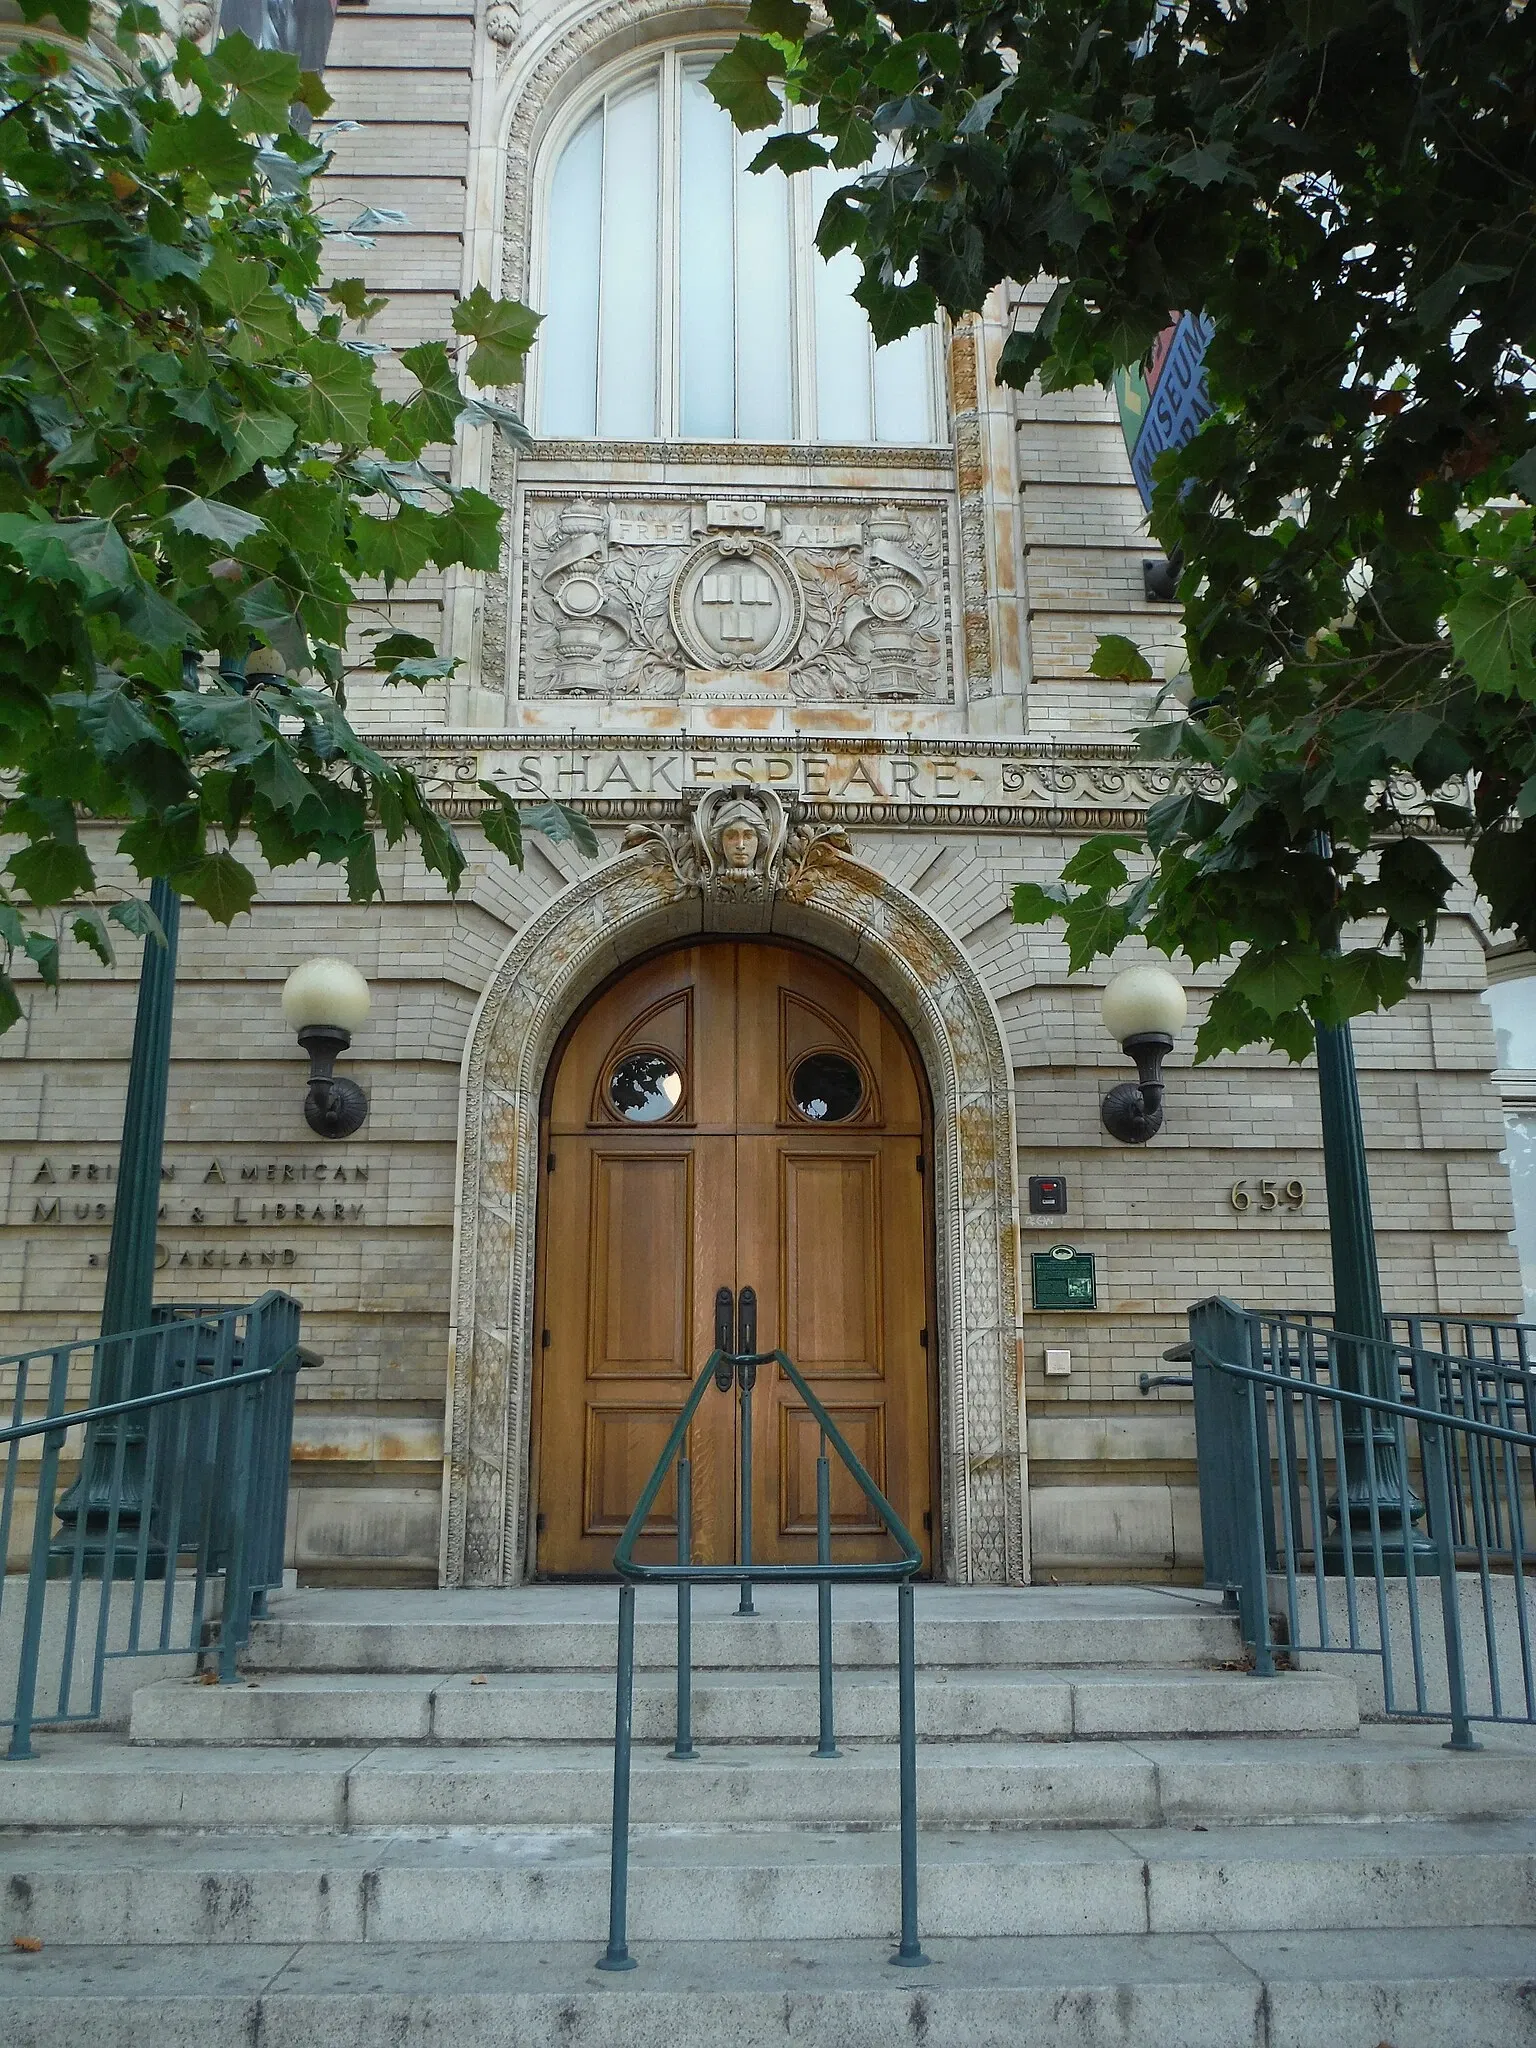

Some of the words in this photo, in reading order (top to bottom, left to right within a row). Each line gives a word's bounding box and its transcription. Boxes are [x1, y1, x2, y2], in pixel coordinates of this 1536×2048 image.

[1137, 312, 1208, 490] MUSEUM
[619, 523, 687, 543] FREE
[715, 504, 758, 522] TO
[795, 527, 848, 545] ALL
[515, 754, 961, 799] SHAKESPEARE
[32, 1157, 177, 1185] AFRIN
[203, 1157, 371, 1185] AMERICAN
[32, 1196, 168, 1224] MUSM
[190, 1206, 205, 1224] &
[233, 1196, 366, 1224] LIBRARY
[1230, 1179, 1306, 1212] 659
